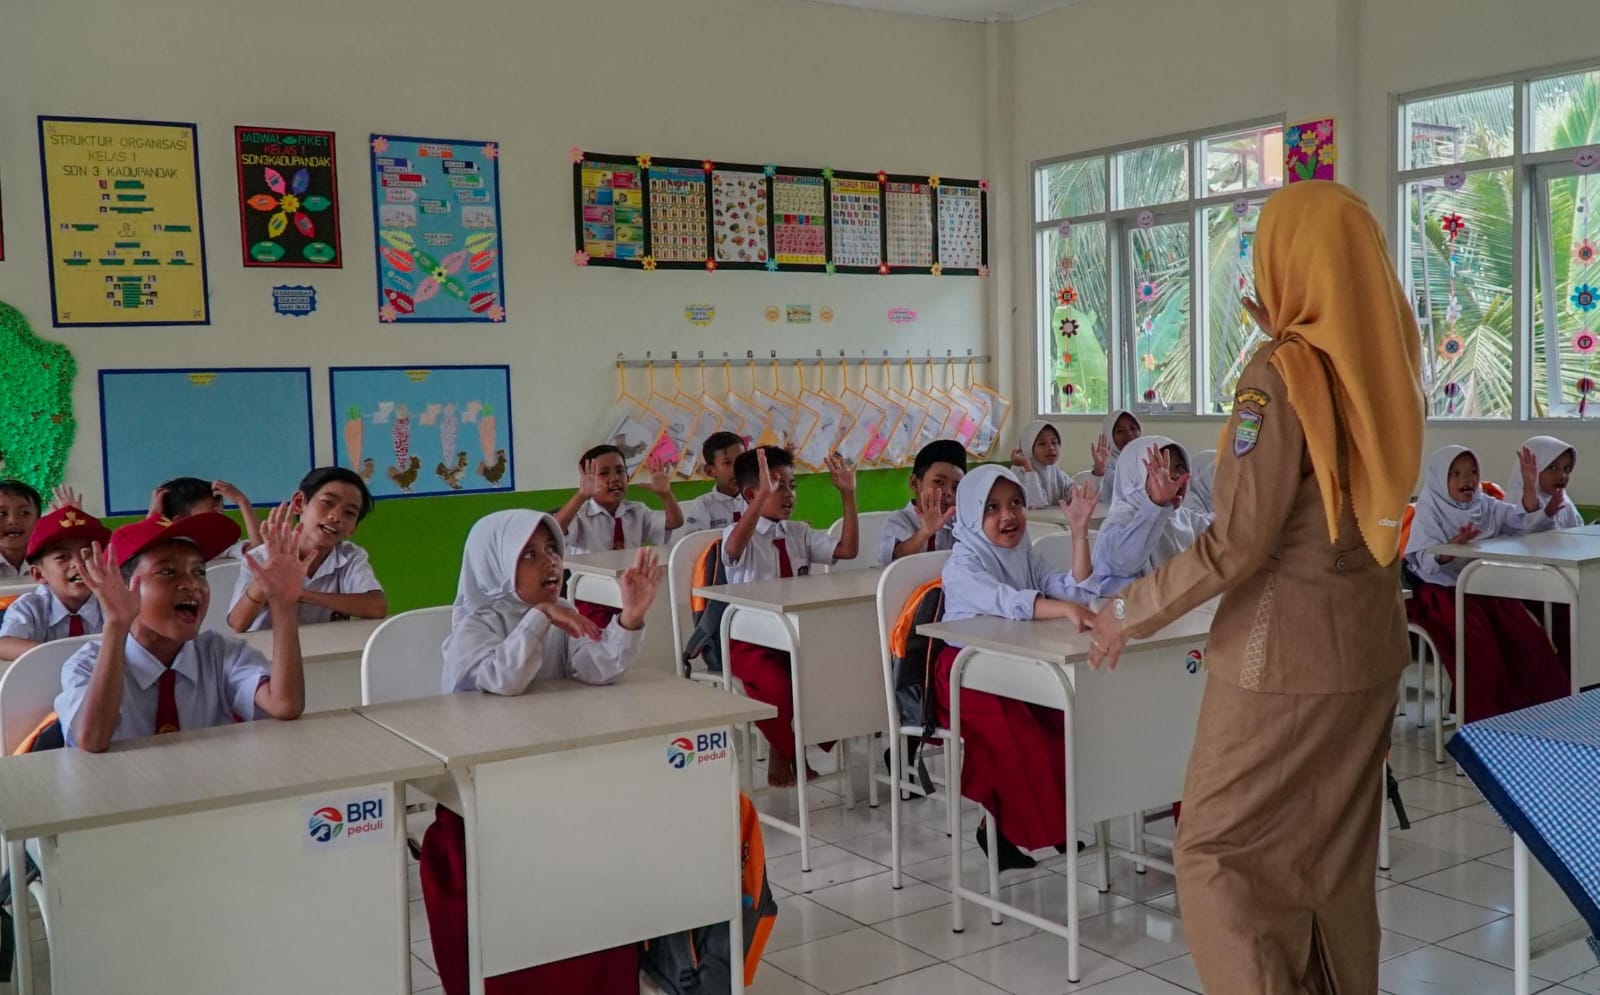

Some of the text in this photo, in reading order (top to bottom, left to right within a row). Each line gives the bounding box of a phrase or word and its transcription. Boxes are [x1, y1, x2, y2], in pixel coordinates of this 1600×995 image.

[50, 134, 187, 151] STRUKTUR ORGANISASI
[241, 132, 329, 147] JADWAL PIKET
[88, 151, 137, 162] KELAS 1
[63, 165, 178, 179] SDN 3 KADUPANDAK
[697, 731, 727, 752] BRI
[697, 750, 726, 765] peduli
[347, 798, 383, 823] BRI
[347, 819, 383, 837] peduli
